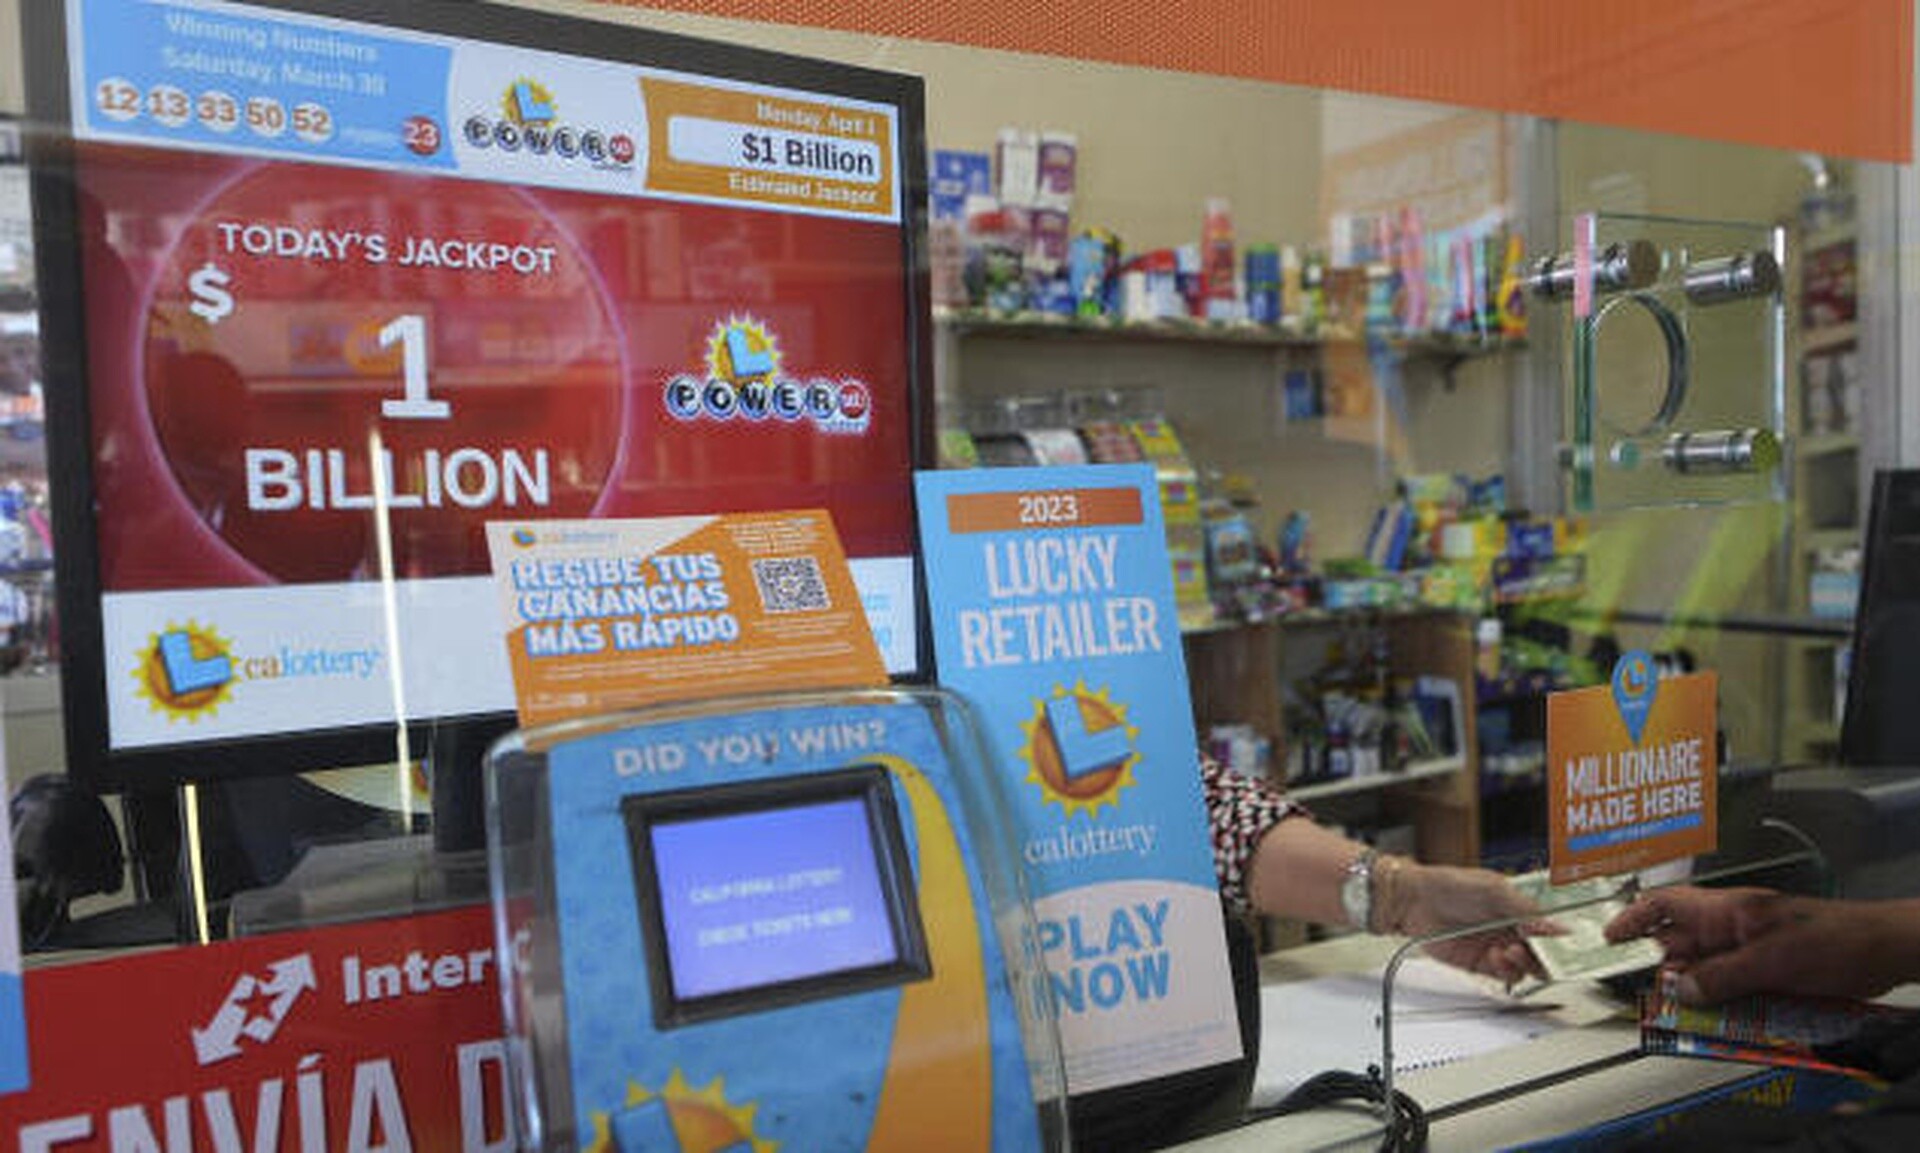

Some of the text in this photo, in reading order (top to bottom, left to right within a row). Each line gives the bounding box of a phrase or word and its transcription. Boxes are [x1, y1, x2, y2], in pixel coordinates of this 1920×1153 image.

[99, 84, 139, 112] 12
[149, 92, 189, 119] 13
[197, 98, 236, 123] 33
[245, 105, 284, 130] 50
[292, 108, 330, 135] 52
[404, 121, 438, 148] 23
[741, 131, 874, 176] $1 Billion
[217, 222, 557, 274] TODAY'S JACKPOT
[188, 261, 235, 324] $
[378, 313, 452, 420] 1
[244, 446, 551, 512] BILLION
[1017, 494, 1080, 524] 2023
[510, 552, 722, 590] RECIBE TUS
[984, 534, 1118, 599] LUCKY
[243, 645, 380, 681] calottery
[959, 594, 1163, 669] RETAILER
[613, 718, 888, 778] DID YOU WIN?
[1565, 737, 1704, 800] MILLIONAIRE
[1566, 793, 1638, 834] MADE
[1641, 780, 1704, 819] HERE
[1022, 824, 1159, 867] calottery
[1022, 898, 1171, 968] PLAY
[1033, 953, 1171, 1021] NOW
